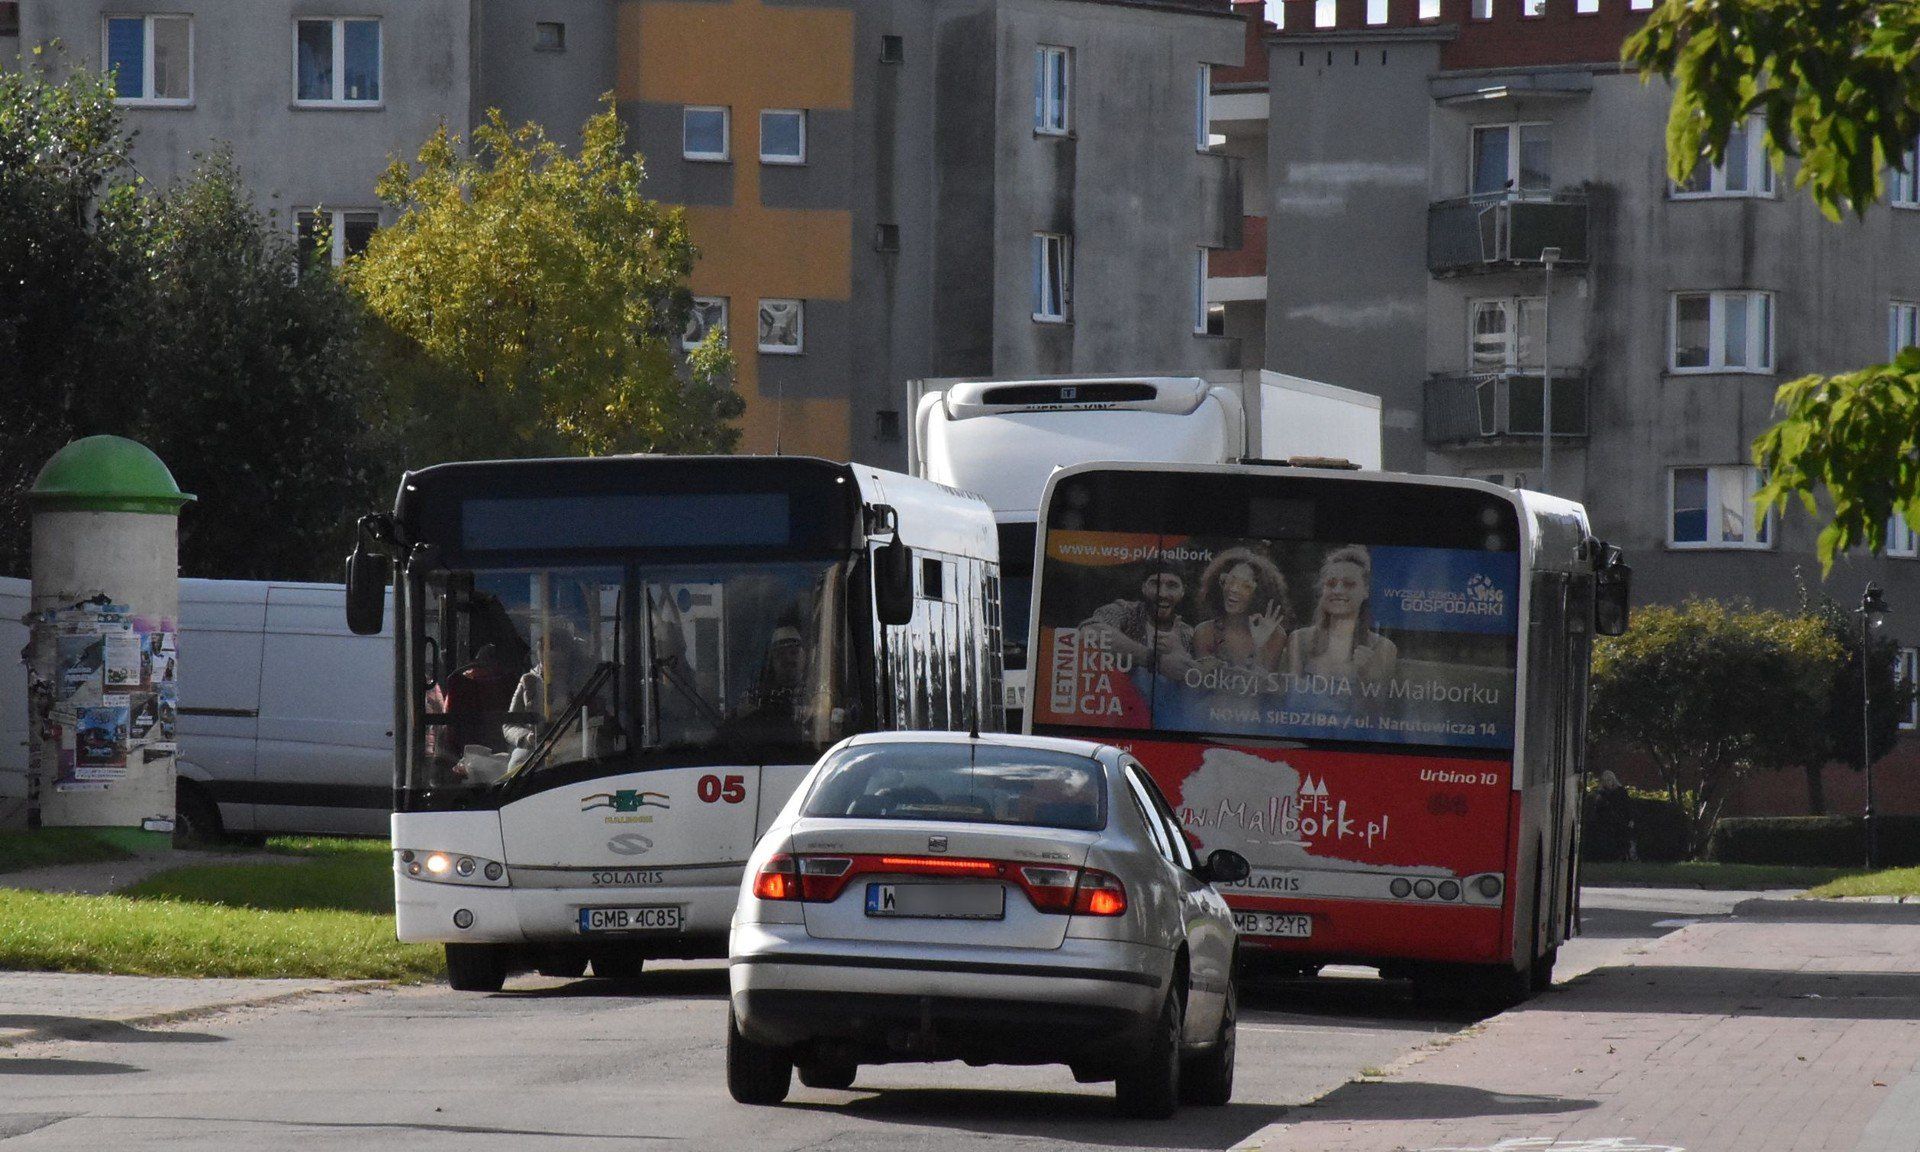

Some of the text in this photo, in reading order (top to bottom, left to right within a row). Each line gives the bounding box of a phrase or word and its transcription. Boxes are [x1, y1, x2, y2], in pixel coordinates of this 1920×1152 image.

[1059, 544, 1213, 563] www.wsg.pl/malbork
[1401, 599, 1503, 616] GOSPODARKI
[1083, 629, 1113, 650] RE
[1056, 632, 1076, 709] LETNIA
[1082, 652, 1133, 673] KRU
[1081, 673, 1113, 693] TA
[1184, 668, 1499, 704] Odkryj STUDIA w Malborku
[1080, 695, 1124, 716] CJA
[1209, 707, 1261, 724] NOWA
[1267, 708, 1338, 727] SIEDZIBA
[1355, 714, 1374, 729] ul.
[1379, 716, 1475, 735] Narutowicza
[1480, 722, 1497, 736] 14
[1420, 769, 1498, 786] Urbino 10
[697, 774, 746, 804] 05
[592, 871, 664, 884] SOLARIS
[592, 910, 629, 928] GMB
[636, 908, 677, 927] 4C85
[1265, 915, 1308, 935] 32YR
